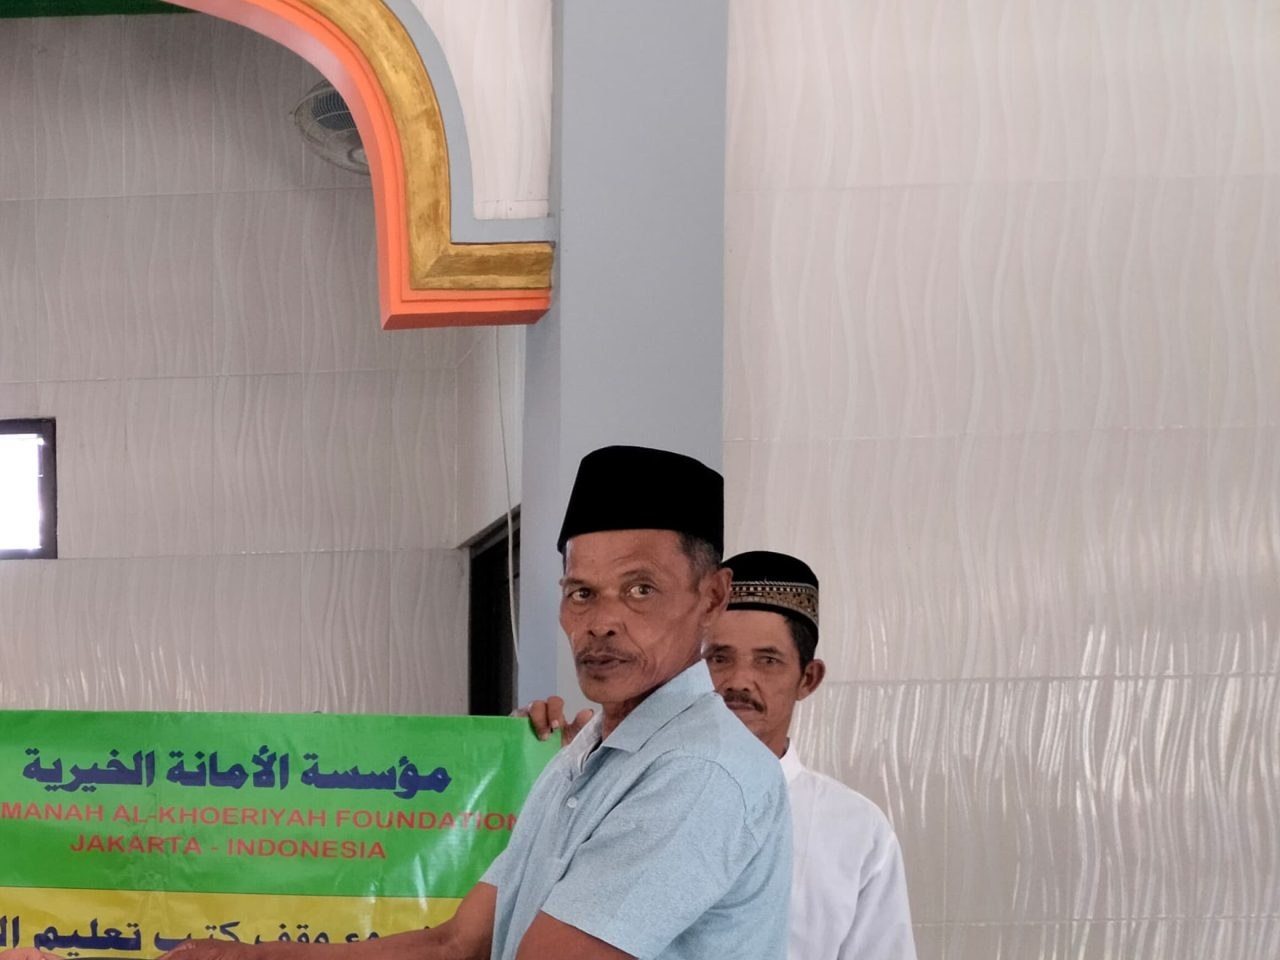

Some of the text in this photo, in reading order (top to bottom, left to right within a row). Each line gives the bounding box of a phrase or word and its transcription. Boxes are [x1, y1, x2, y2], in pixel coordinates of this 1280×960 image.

[22, 744, 452, 799] مؤسسة الأمانة الخيرية
[112, 802, 326, 828] AL-KHOERIYAH
[69, 834, 202, 856] JAKARTA
[227, 840, 386, 860] INDONESIA
[33, 917, 142, 957] تعليم
